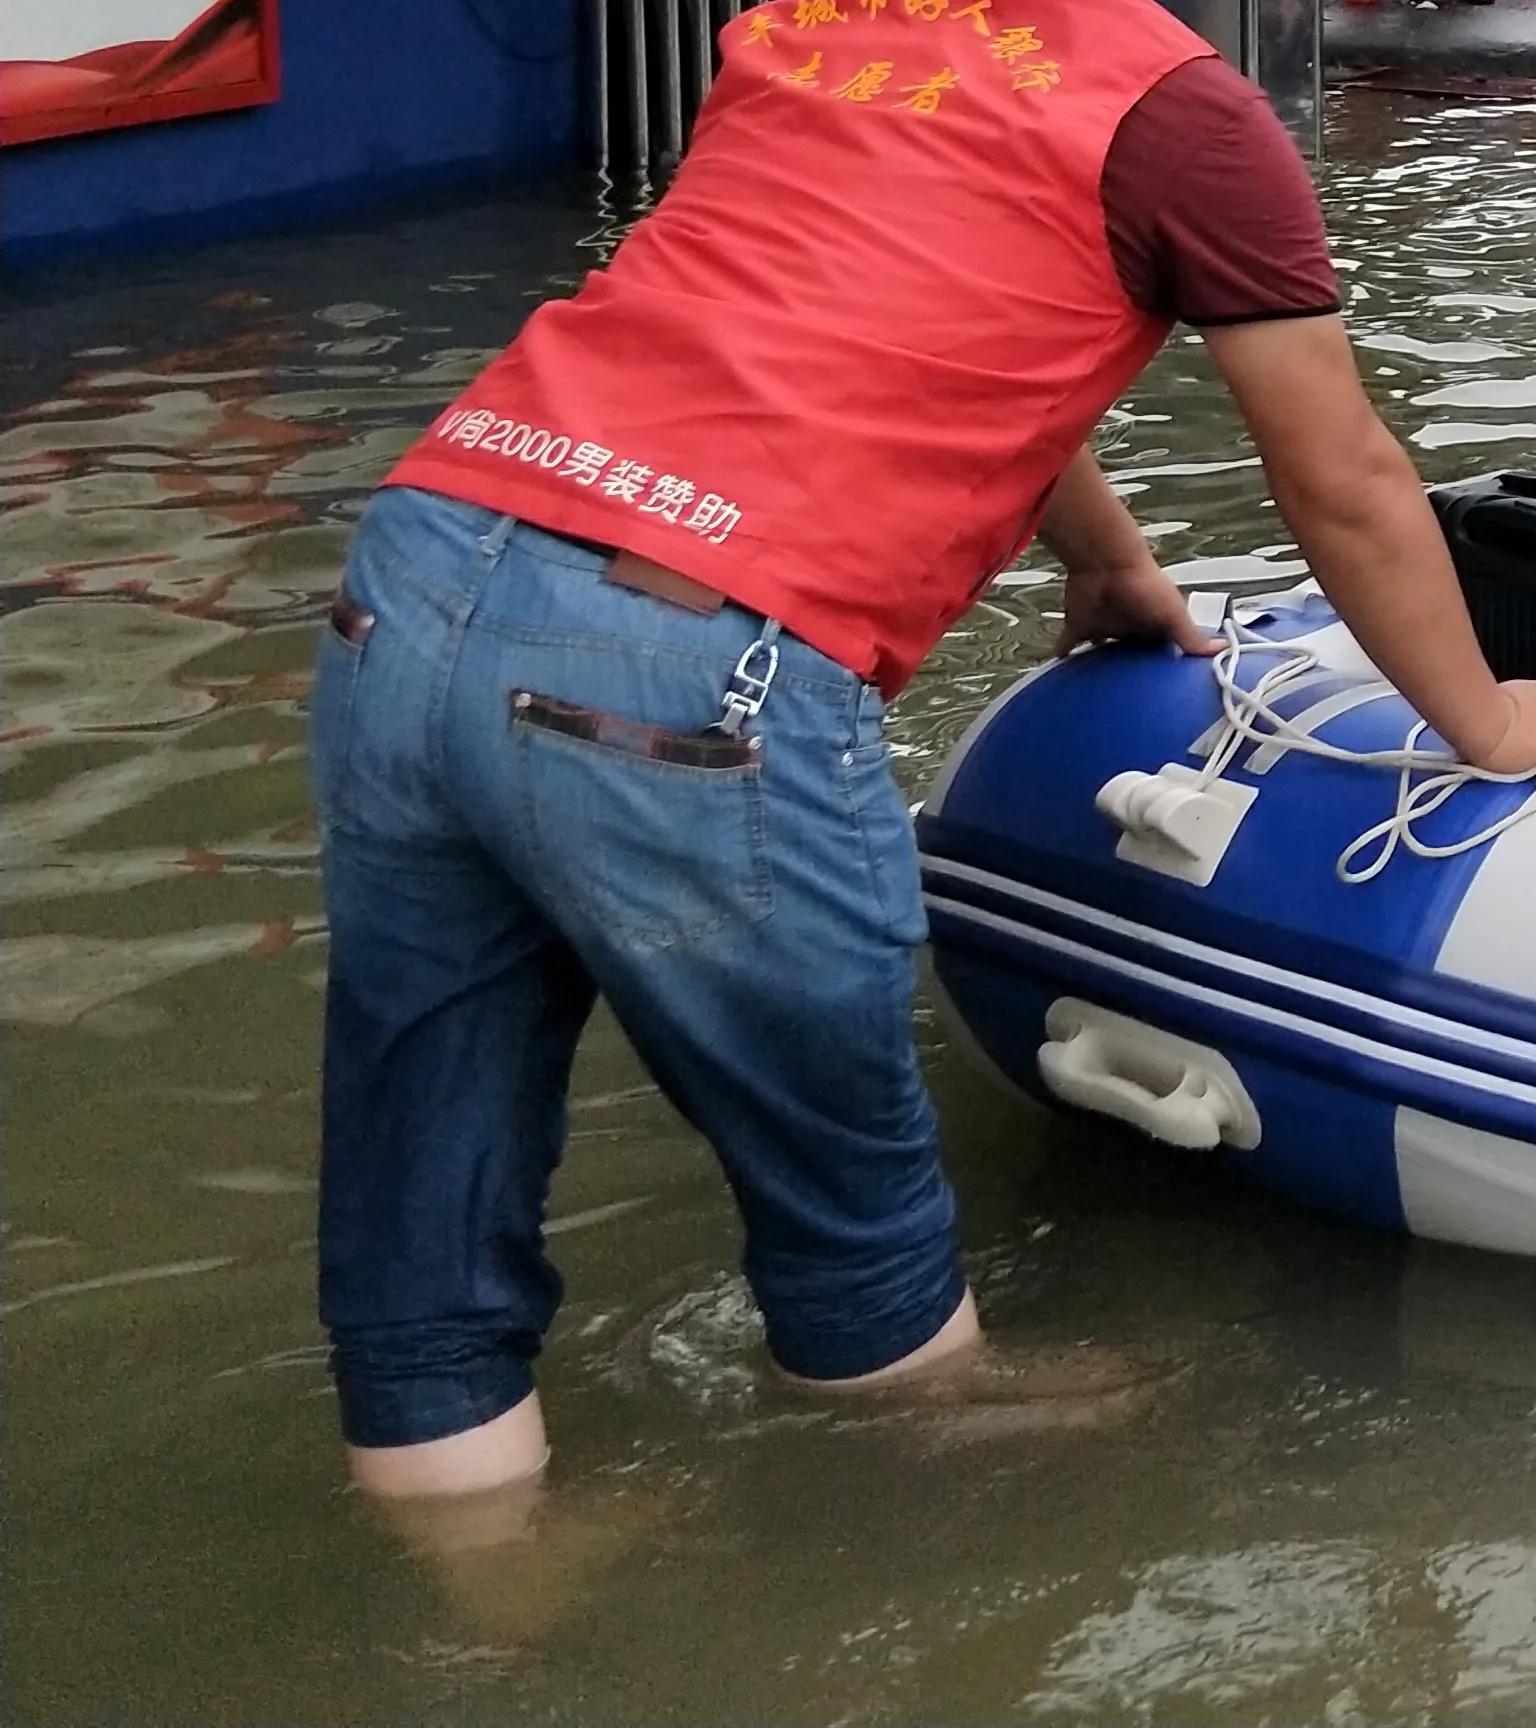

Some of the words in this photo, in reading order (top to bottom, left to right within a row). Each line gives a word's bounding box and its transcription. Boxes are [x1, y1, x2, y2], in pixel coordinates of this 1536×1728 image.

[437, 408, 743, 545] 尚2000男装赞助
